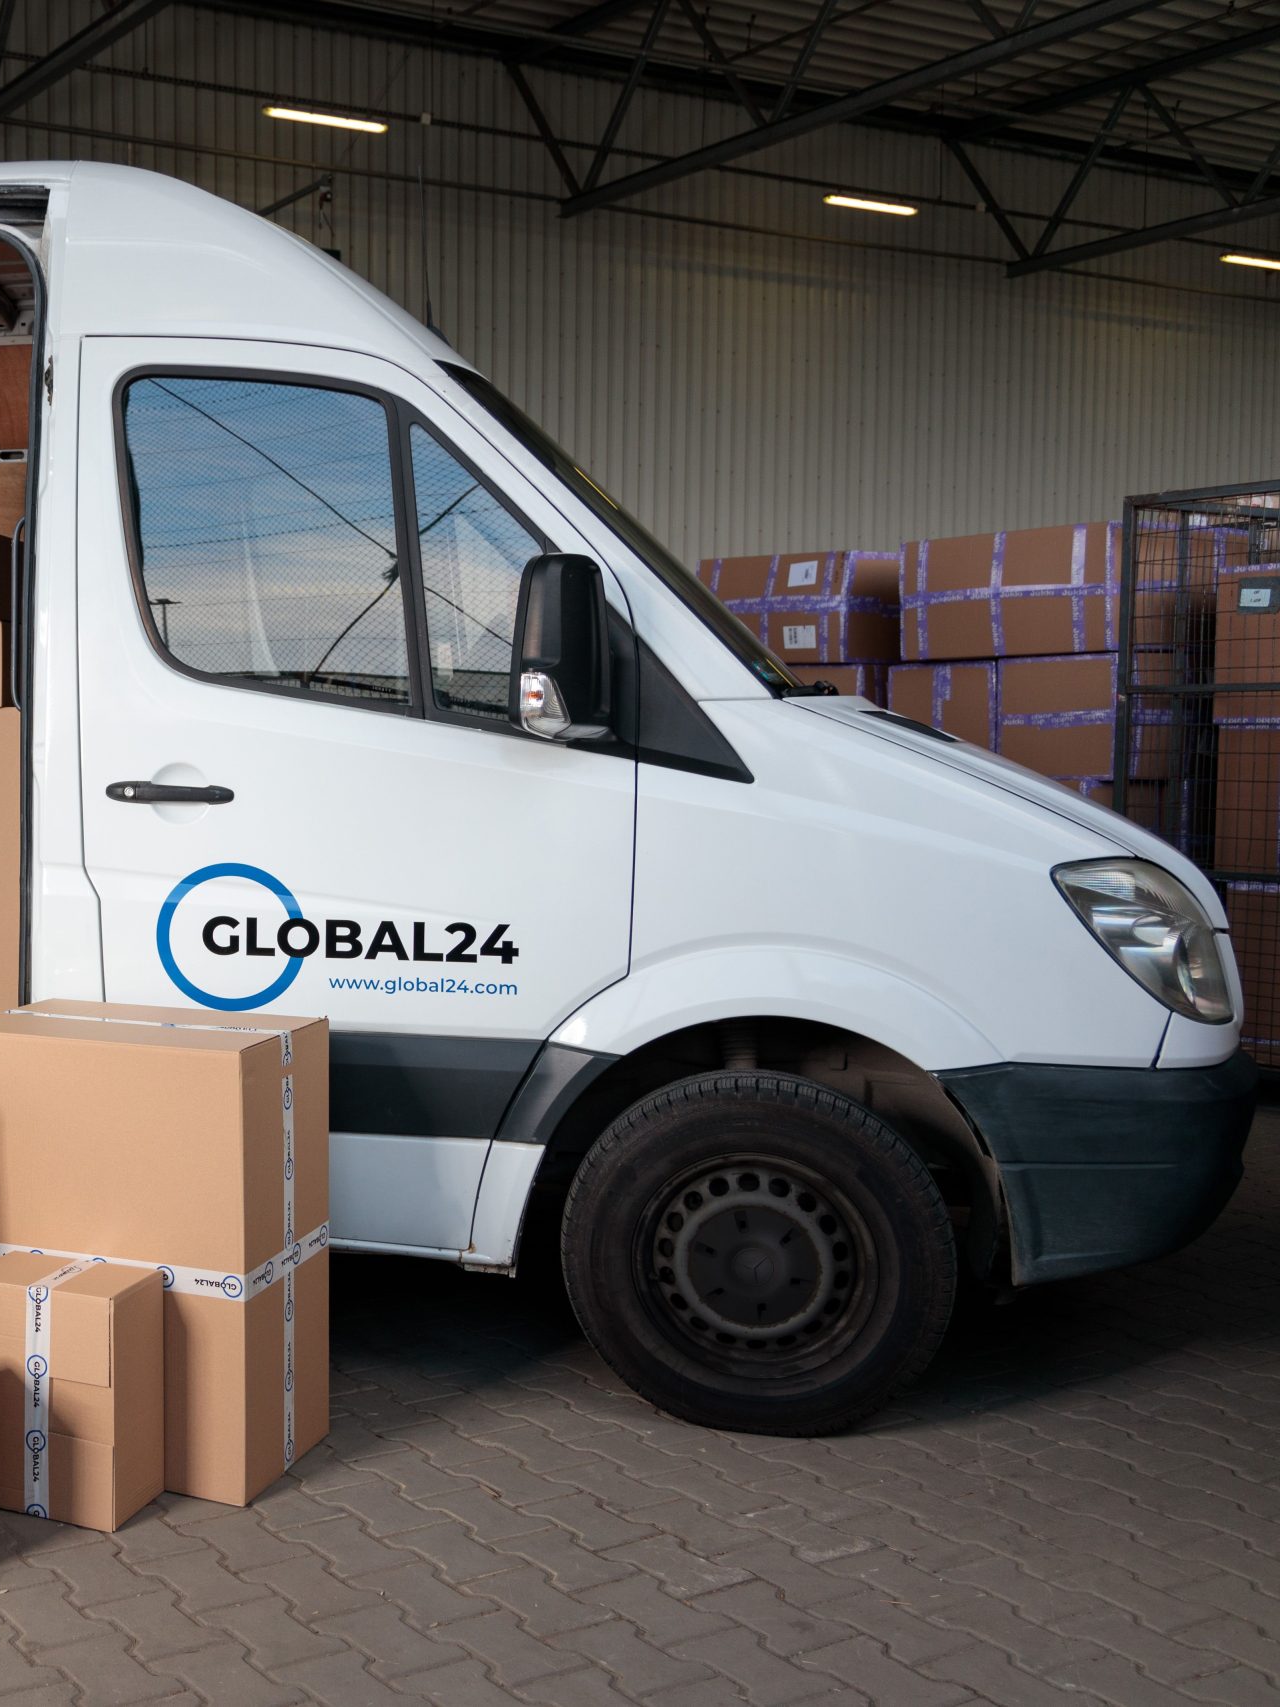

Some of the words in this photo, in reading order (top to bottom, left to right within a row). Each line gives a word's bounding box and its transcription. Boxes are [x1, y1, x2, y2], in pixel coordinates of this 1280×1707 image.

[202, 915, 520, 965] GLOBAL24
[329, 975, 519, 996] www.global24.com
[194, 1278, 237, 1290] GLOBAL24
[32, 1436, 40, 1482] GLOBAL24
